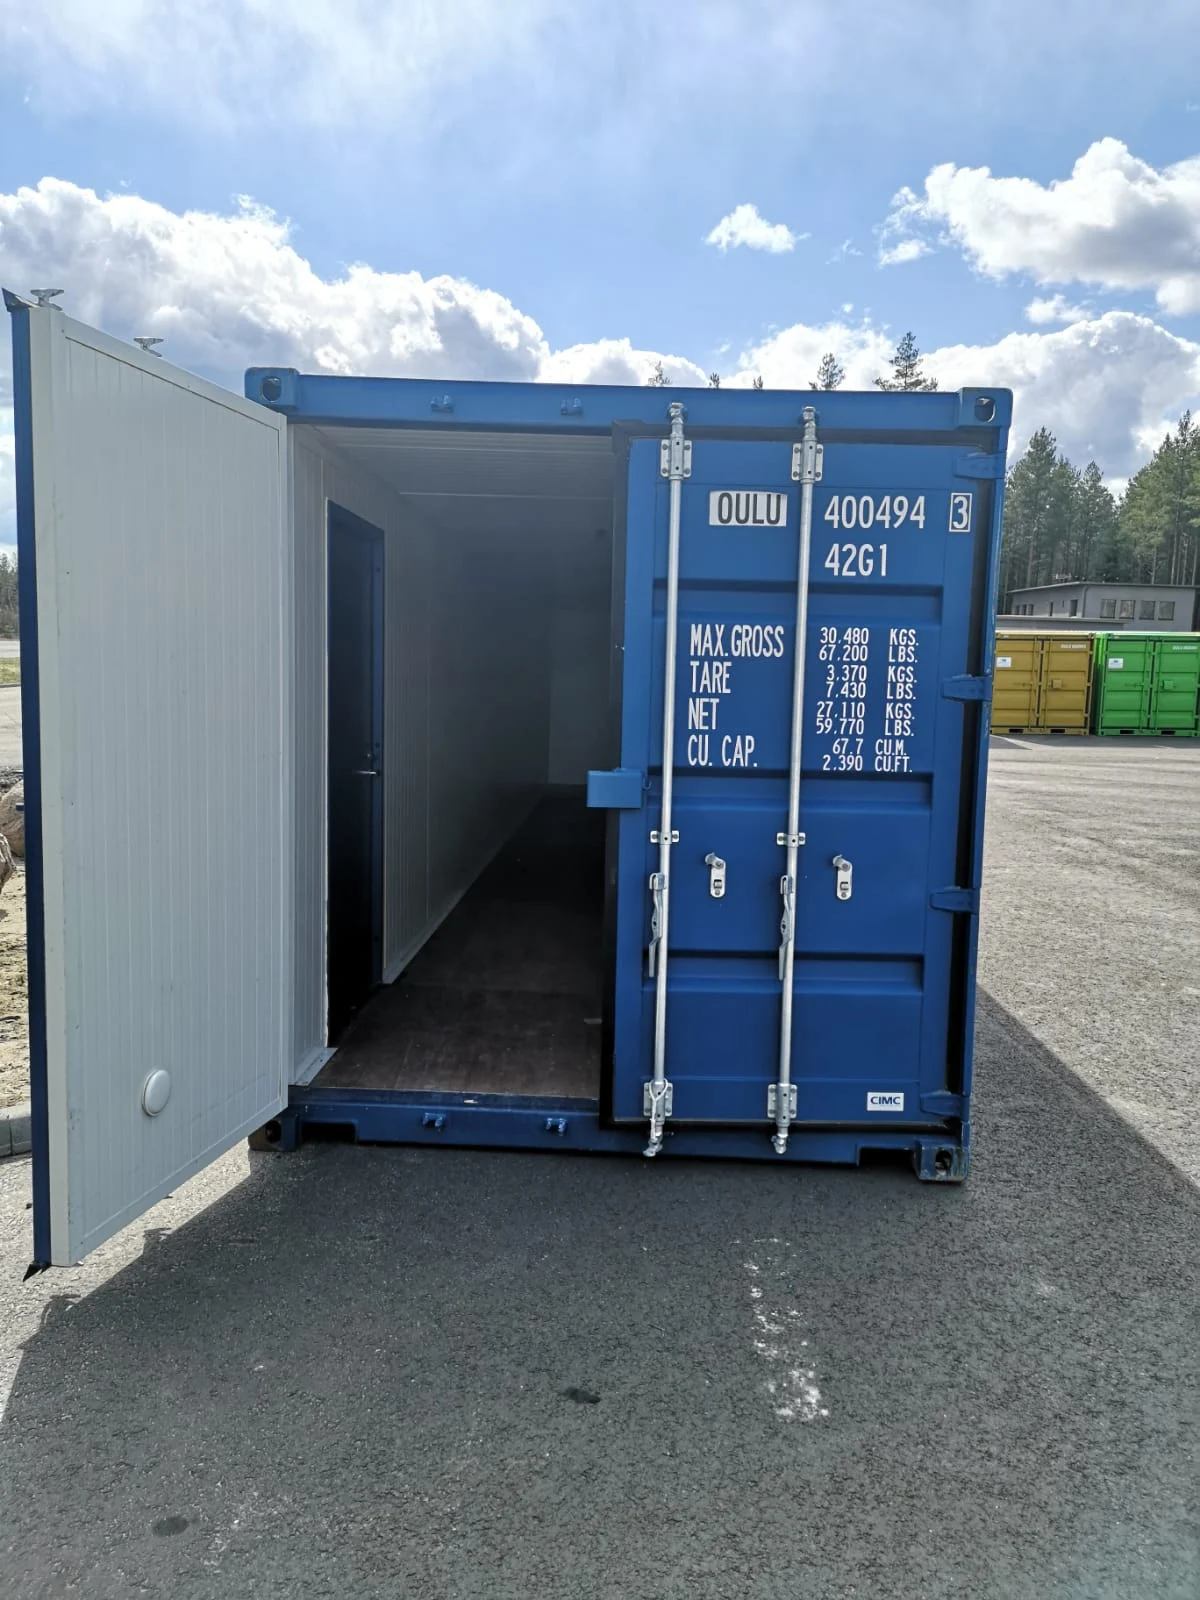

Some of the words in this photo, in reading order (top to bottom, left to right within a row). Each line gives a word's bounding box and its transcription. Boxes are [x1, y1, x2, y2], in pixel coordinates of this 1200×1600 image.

[717, 492, 782, 524] OULU
[824, 495, 926, 529] 400494
[952, 495, 970, 529] 3
[824, 543, 888, 577] 42G1
[889, 628, 920, 646] KGS.
[888, 645, 919, 663] LBS.
[689, 660, 733, 694] TARE
[887, 666, 918, 683] KGS.
[886, 683, 917, 700] LBS.
[687, 697, 720, 730] NET
[885, 702, 916, 720] KGS.
[884, 719, 915, 737] LBS.
[687, 734, 713, 767] CU.
[721, 735, 758, 768] CAP.
[832, 738, 864, 754] 67.7
[870, 1096, 901, 1105] CIMC
